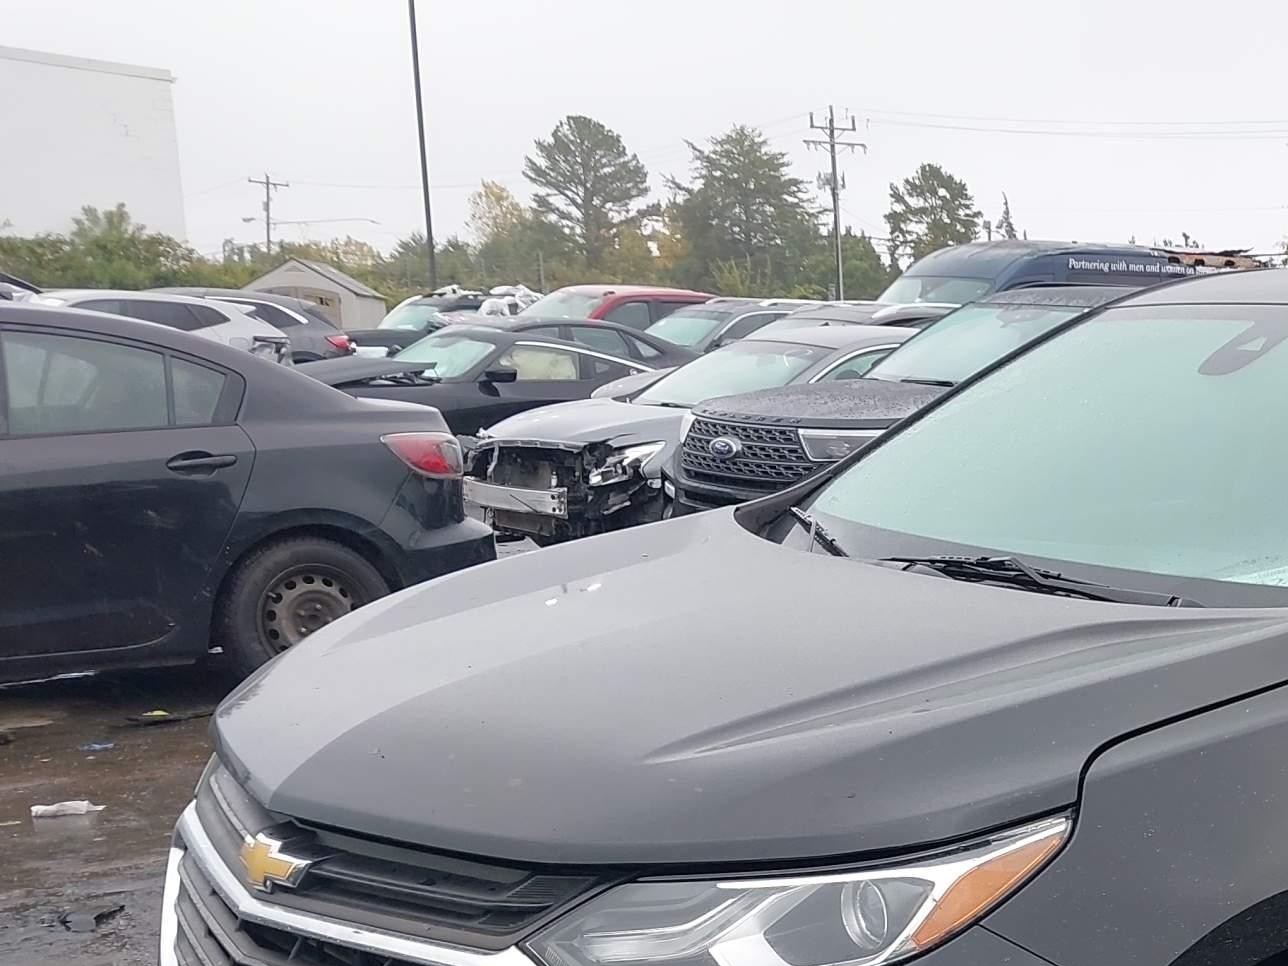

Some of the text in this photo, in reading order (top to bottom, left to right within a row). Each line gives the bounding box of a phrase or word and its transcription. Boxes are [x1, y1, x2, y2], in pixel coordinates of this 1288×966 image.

[1068, 257, 1110, 273] Partnering
[1110, 259, 1128, 272] with
[1128, 263, 1145, 273] men
[1145, 262, 1160, 273] and
